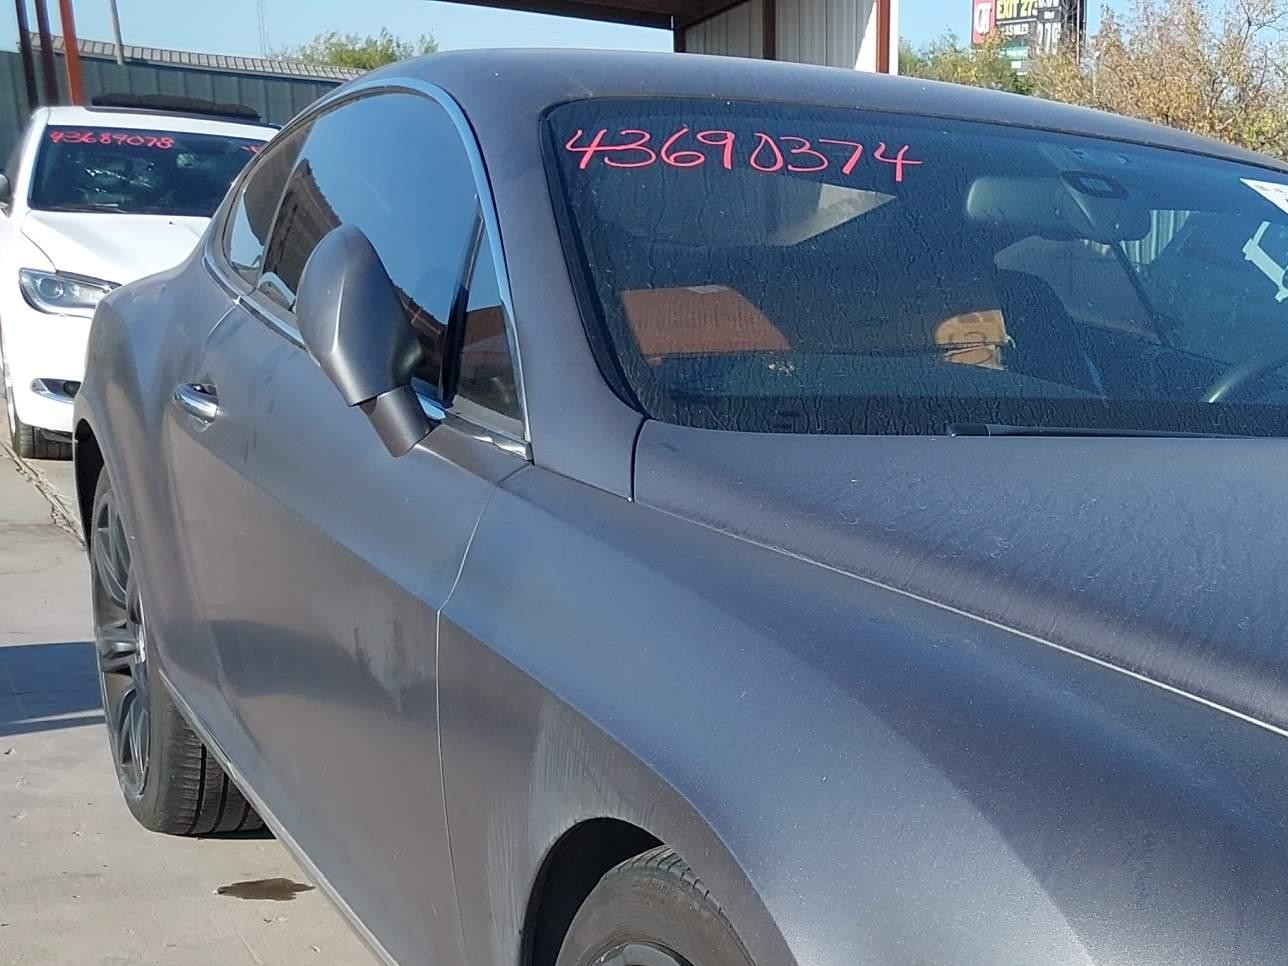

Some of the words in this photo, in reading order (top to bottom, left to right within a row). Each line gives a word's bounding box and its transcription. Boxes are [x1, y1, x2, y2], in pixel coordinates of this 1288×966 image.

[996, 0, 1018, 19] EXIT
[50, 131, 176, 149] 43689078
[565, 124, 922, 182] 43690374
